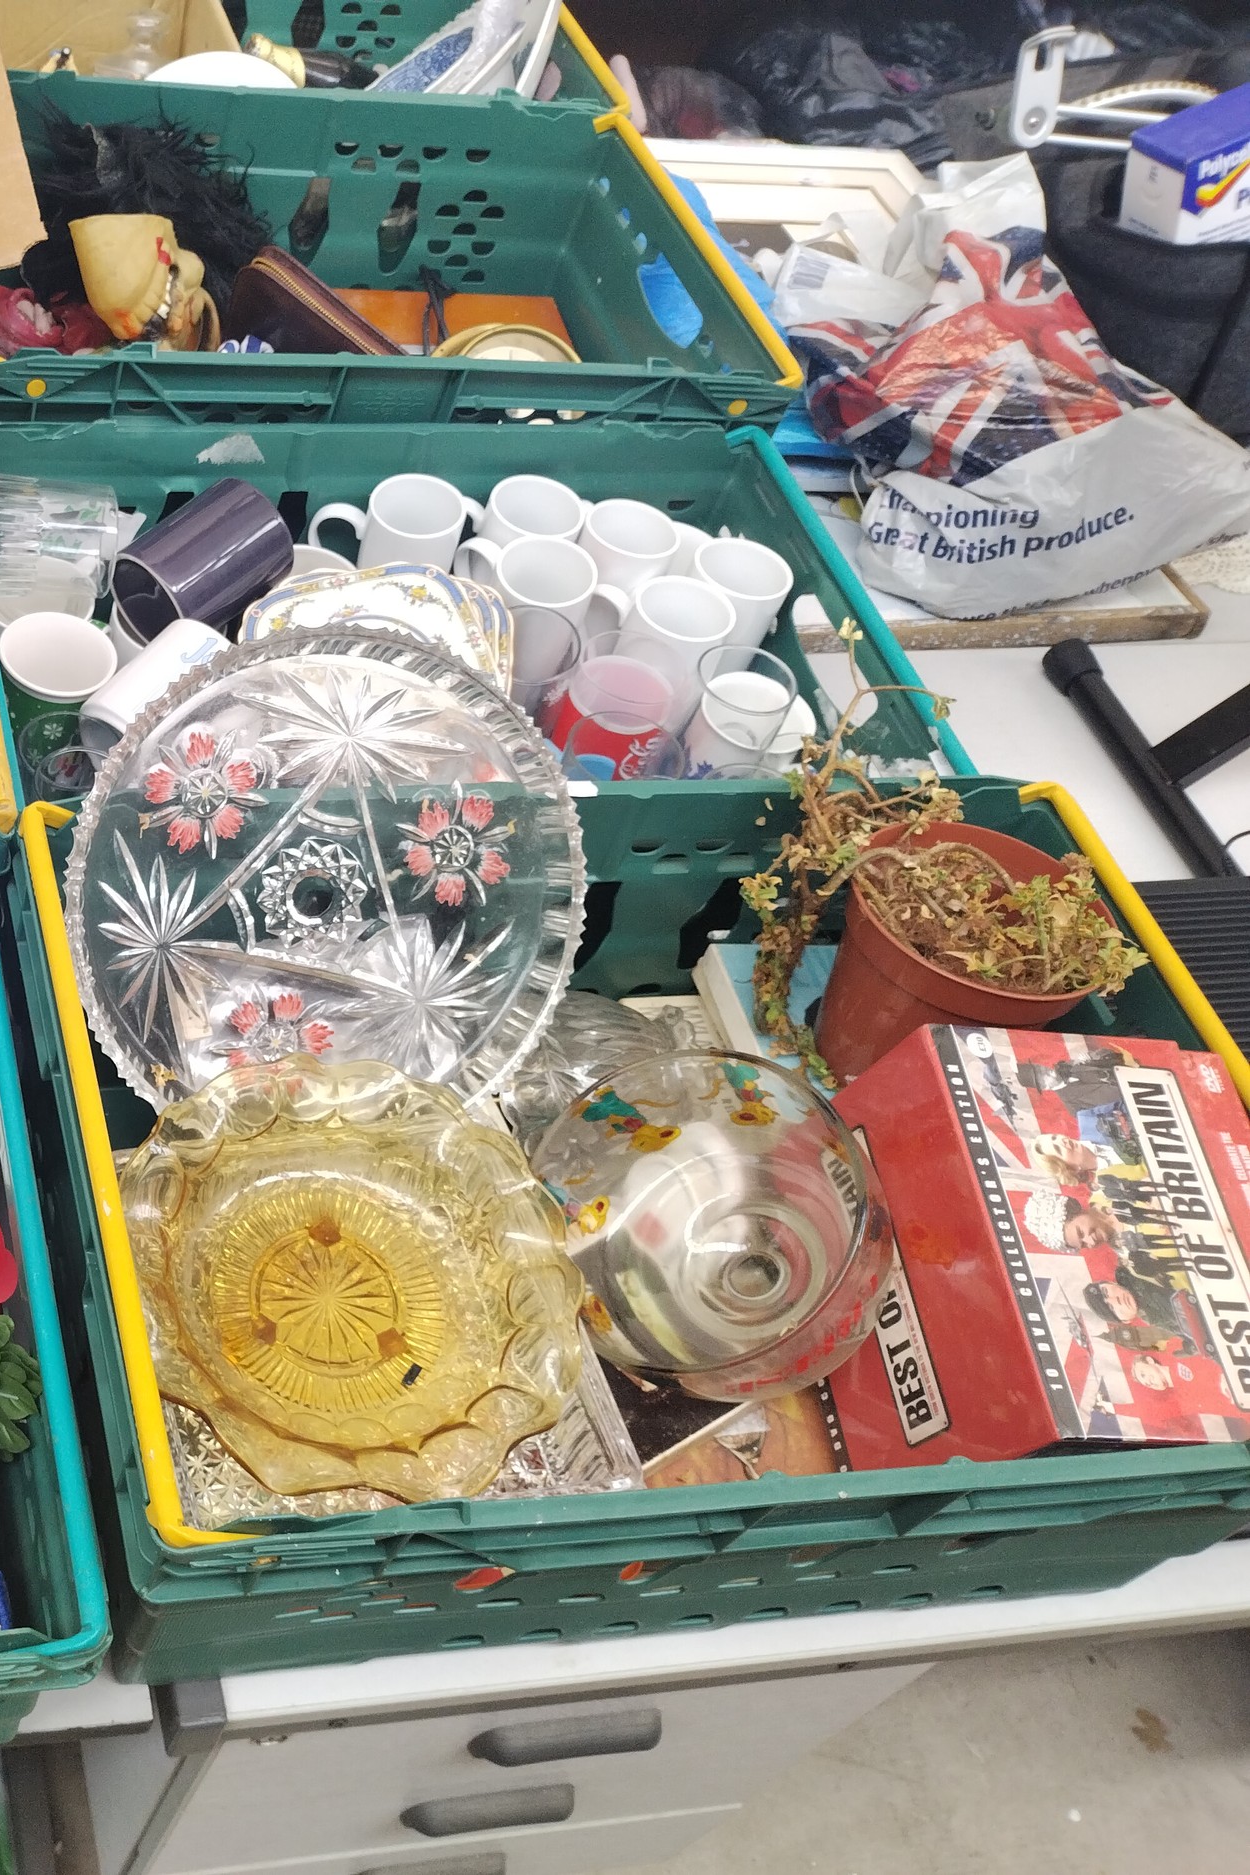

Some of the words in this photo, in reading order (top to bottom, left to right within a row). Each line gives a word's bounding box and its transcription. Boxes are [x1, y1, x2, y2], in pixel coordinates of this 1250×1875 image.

[1023, 506, 1135, 558] produce.
[946, 1064, 983, 1144] EDITION
[1127, 1081, 1214, 1221] BRITAIN
[976, 1157, 1034, 1297] COLLECTOR'S
[1183, 1233, 1235, 1280] OF
[1027, 1312, 1051, 1352] DVD
[886, 1339, 933, 1430] BEST
[1044, 1368, 1064, 1391] 10
